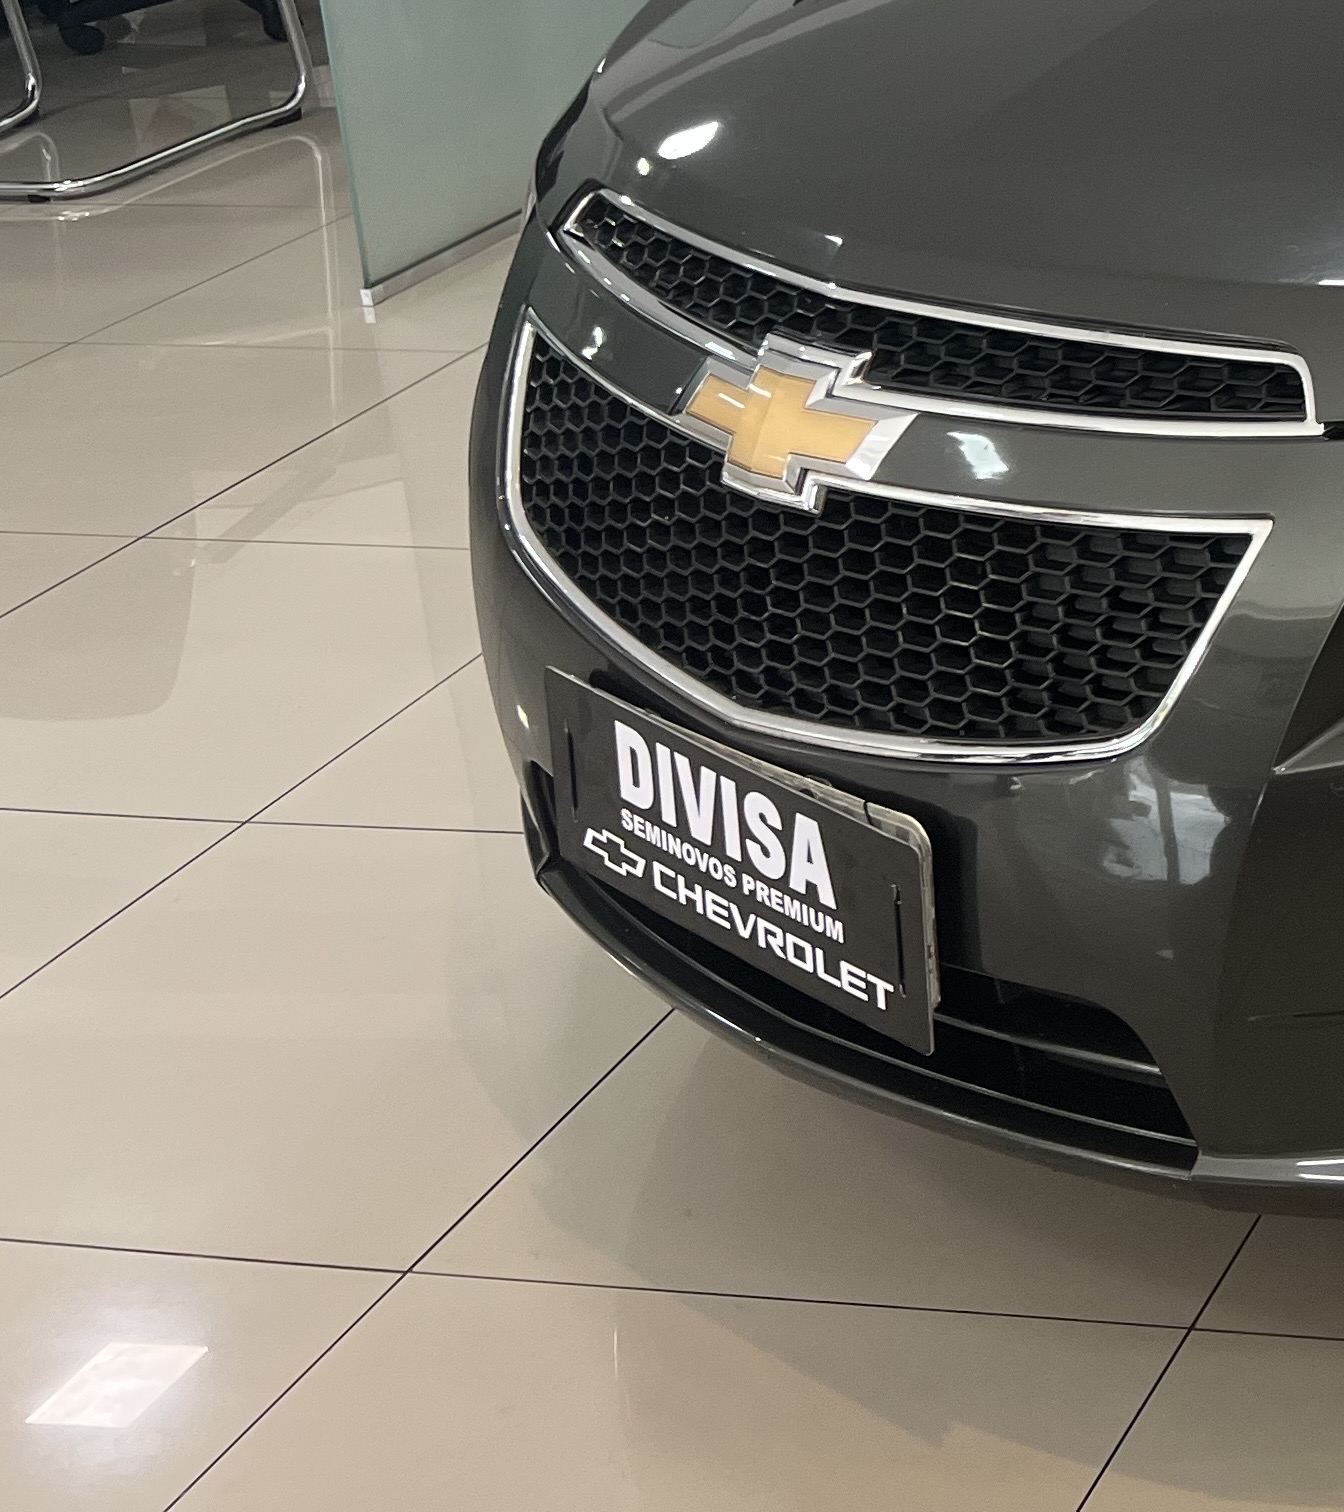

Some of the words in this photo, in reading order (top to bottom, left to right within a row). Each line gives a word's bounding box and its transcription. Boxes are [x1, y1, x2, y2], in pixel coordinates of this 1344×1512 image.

[614, 719, 837, 910] DIVISA
[620, 807, 738, 889] SEMINOVOS
[741, 872, 845, 945] PREMIUM
[652, 860, 895, 1011] CHEVROLET
